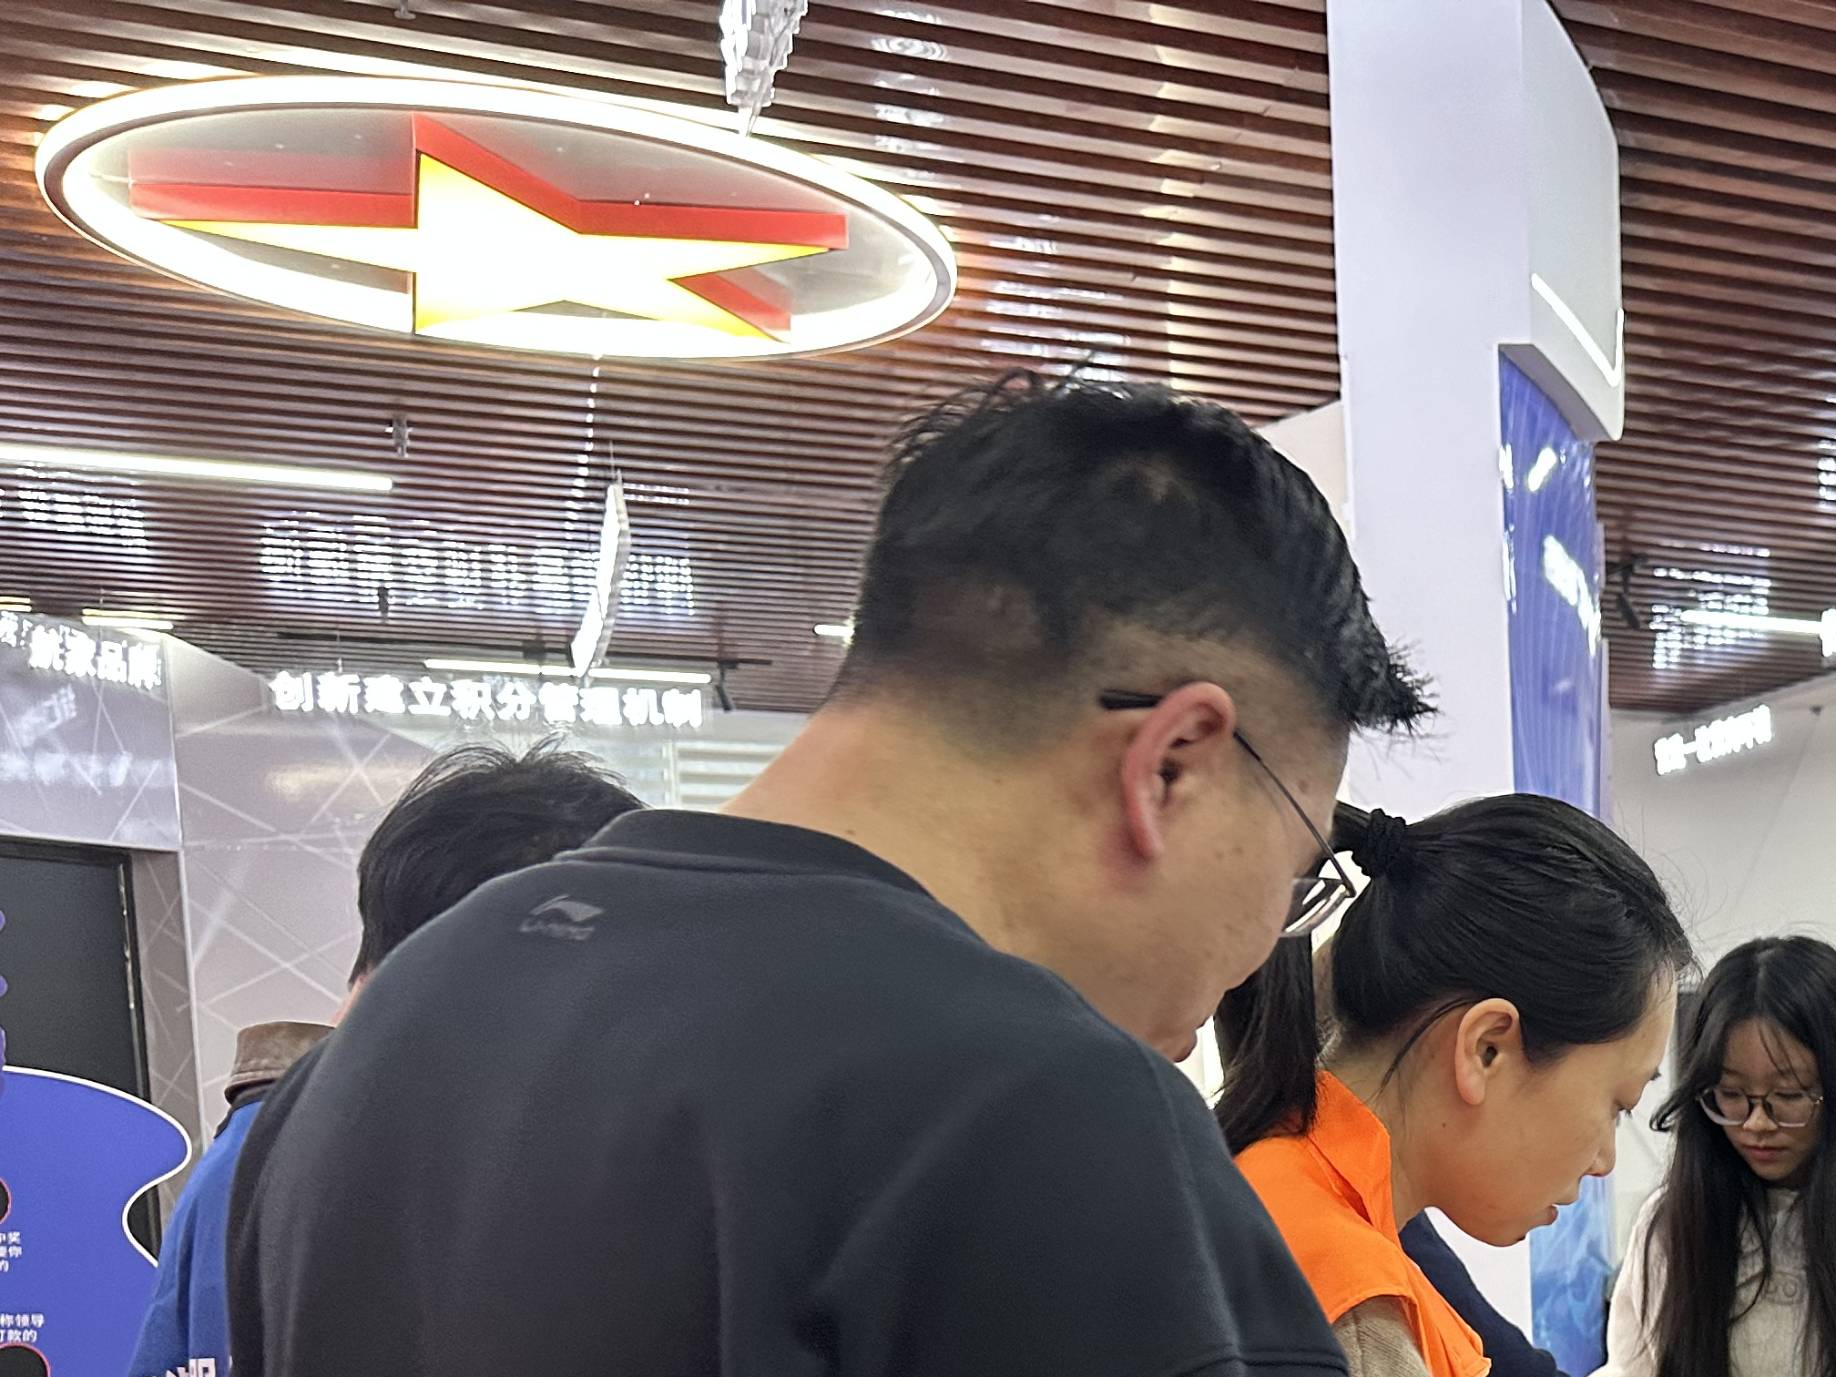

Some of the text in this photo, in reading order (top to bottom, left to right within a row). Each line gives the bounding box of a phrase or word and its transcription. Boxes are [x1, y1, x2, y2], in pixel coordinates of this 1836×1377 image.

[270, 671, 703, 727] 创新建立积分管理机制
